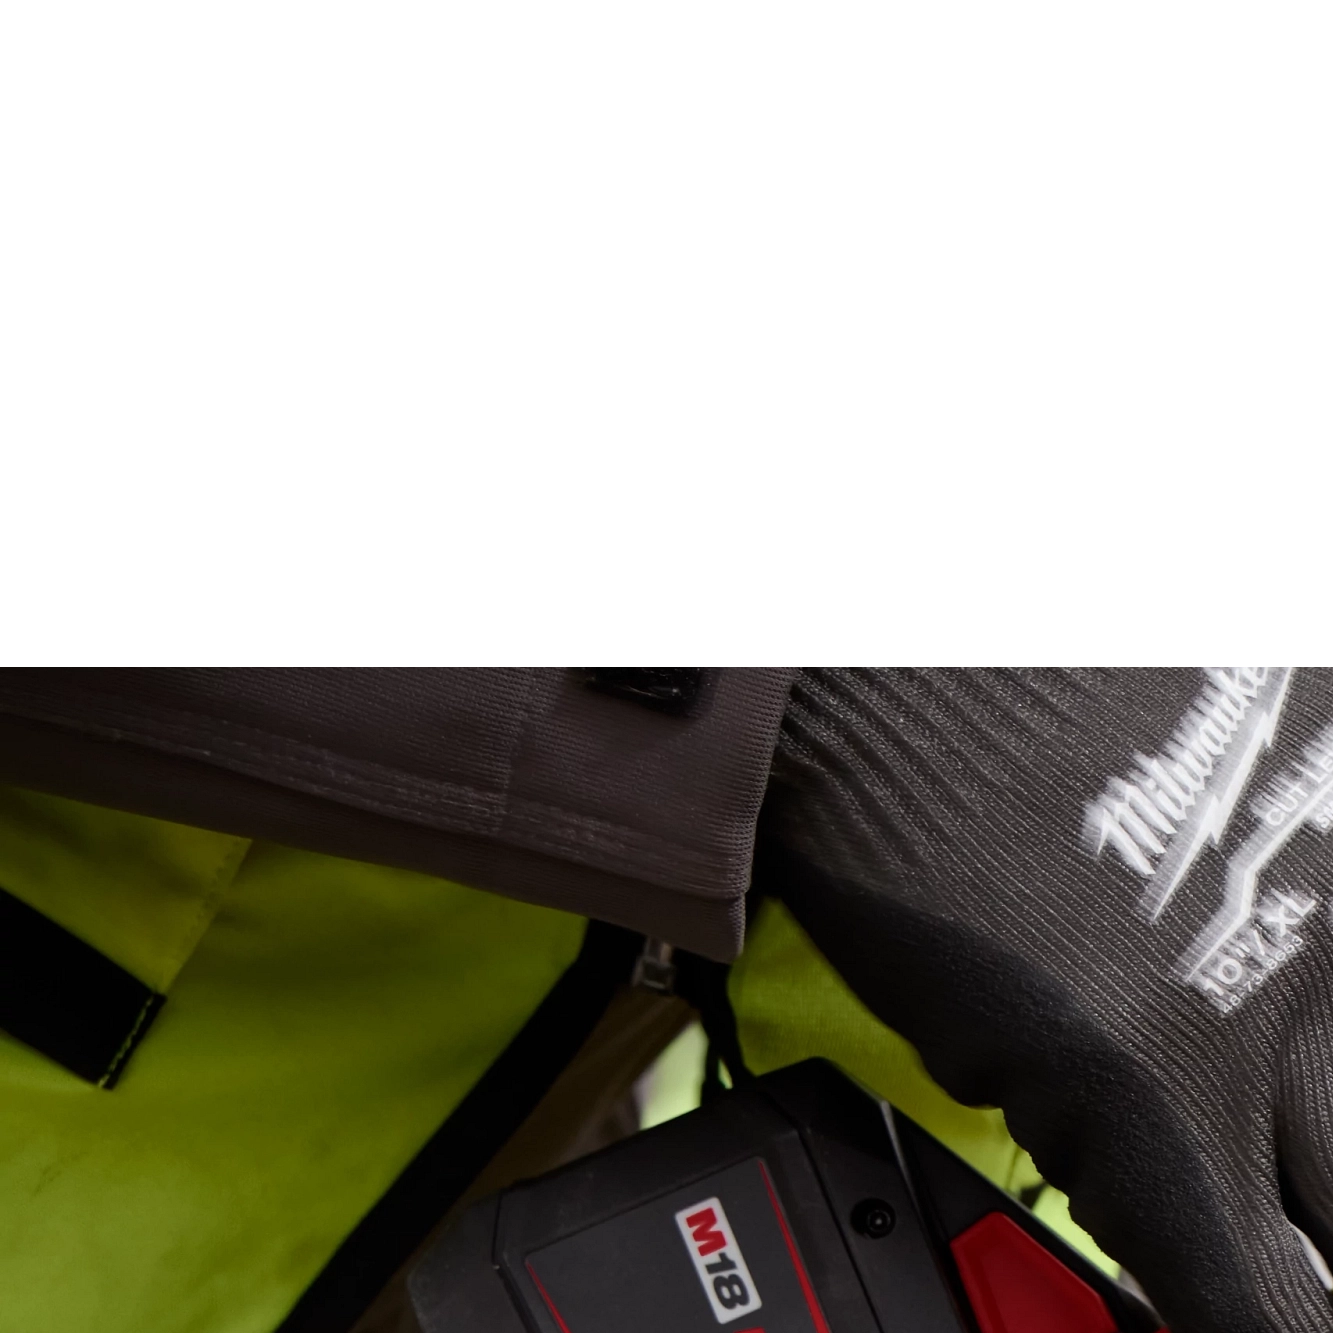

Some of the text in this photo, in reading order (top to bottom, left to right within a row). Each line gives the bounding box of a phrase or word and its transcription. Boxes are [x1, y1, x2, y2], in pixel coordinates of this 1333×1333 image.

[1264, 781, 1309, 826] CUT
[1222, 936, 1304, 1014] 48-73-8653
[686, 1206, 751, 1310] M18
